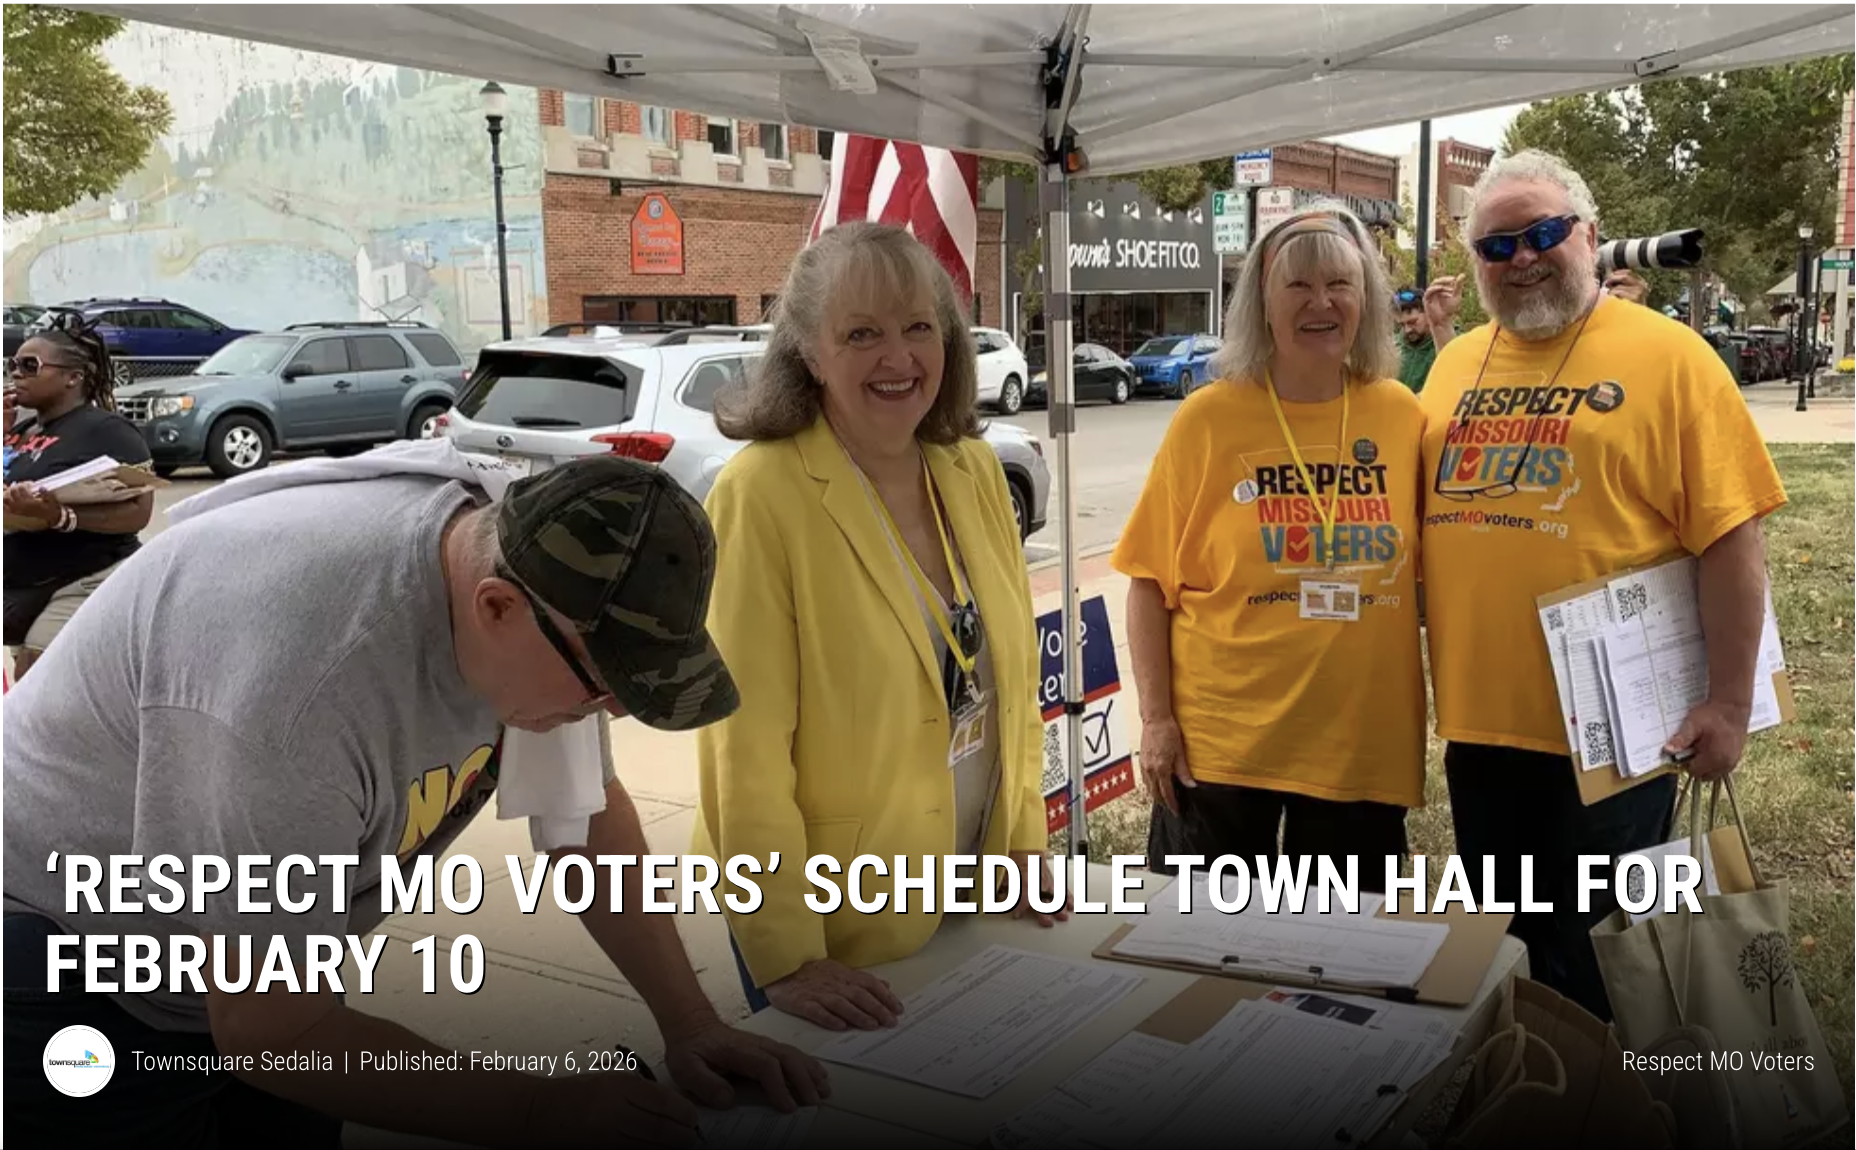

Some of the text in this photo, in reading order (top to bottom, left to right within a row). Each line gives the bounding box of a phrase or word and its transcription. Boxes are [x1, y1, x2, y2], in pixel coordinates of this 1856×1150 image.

[1453, 386, 1588, 416] RESPECT
[1448, 418, 1571, 445] MISSOURI
[1256, 463, 1388, 496] RESPECT
[1440, 446, 1566, 486] VOTERS
[1258, 497, 1391, 523] MISSOURI
[1261, 524, 1398, 563] VOTERS
